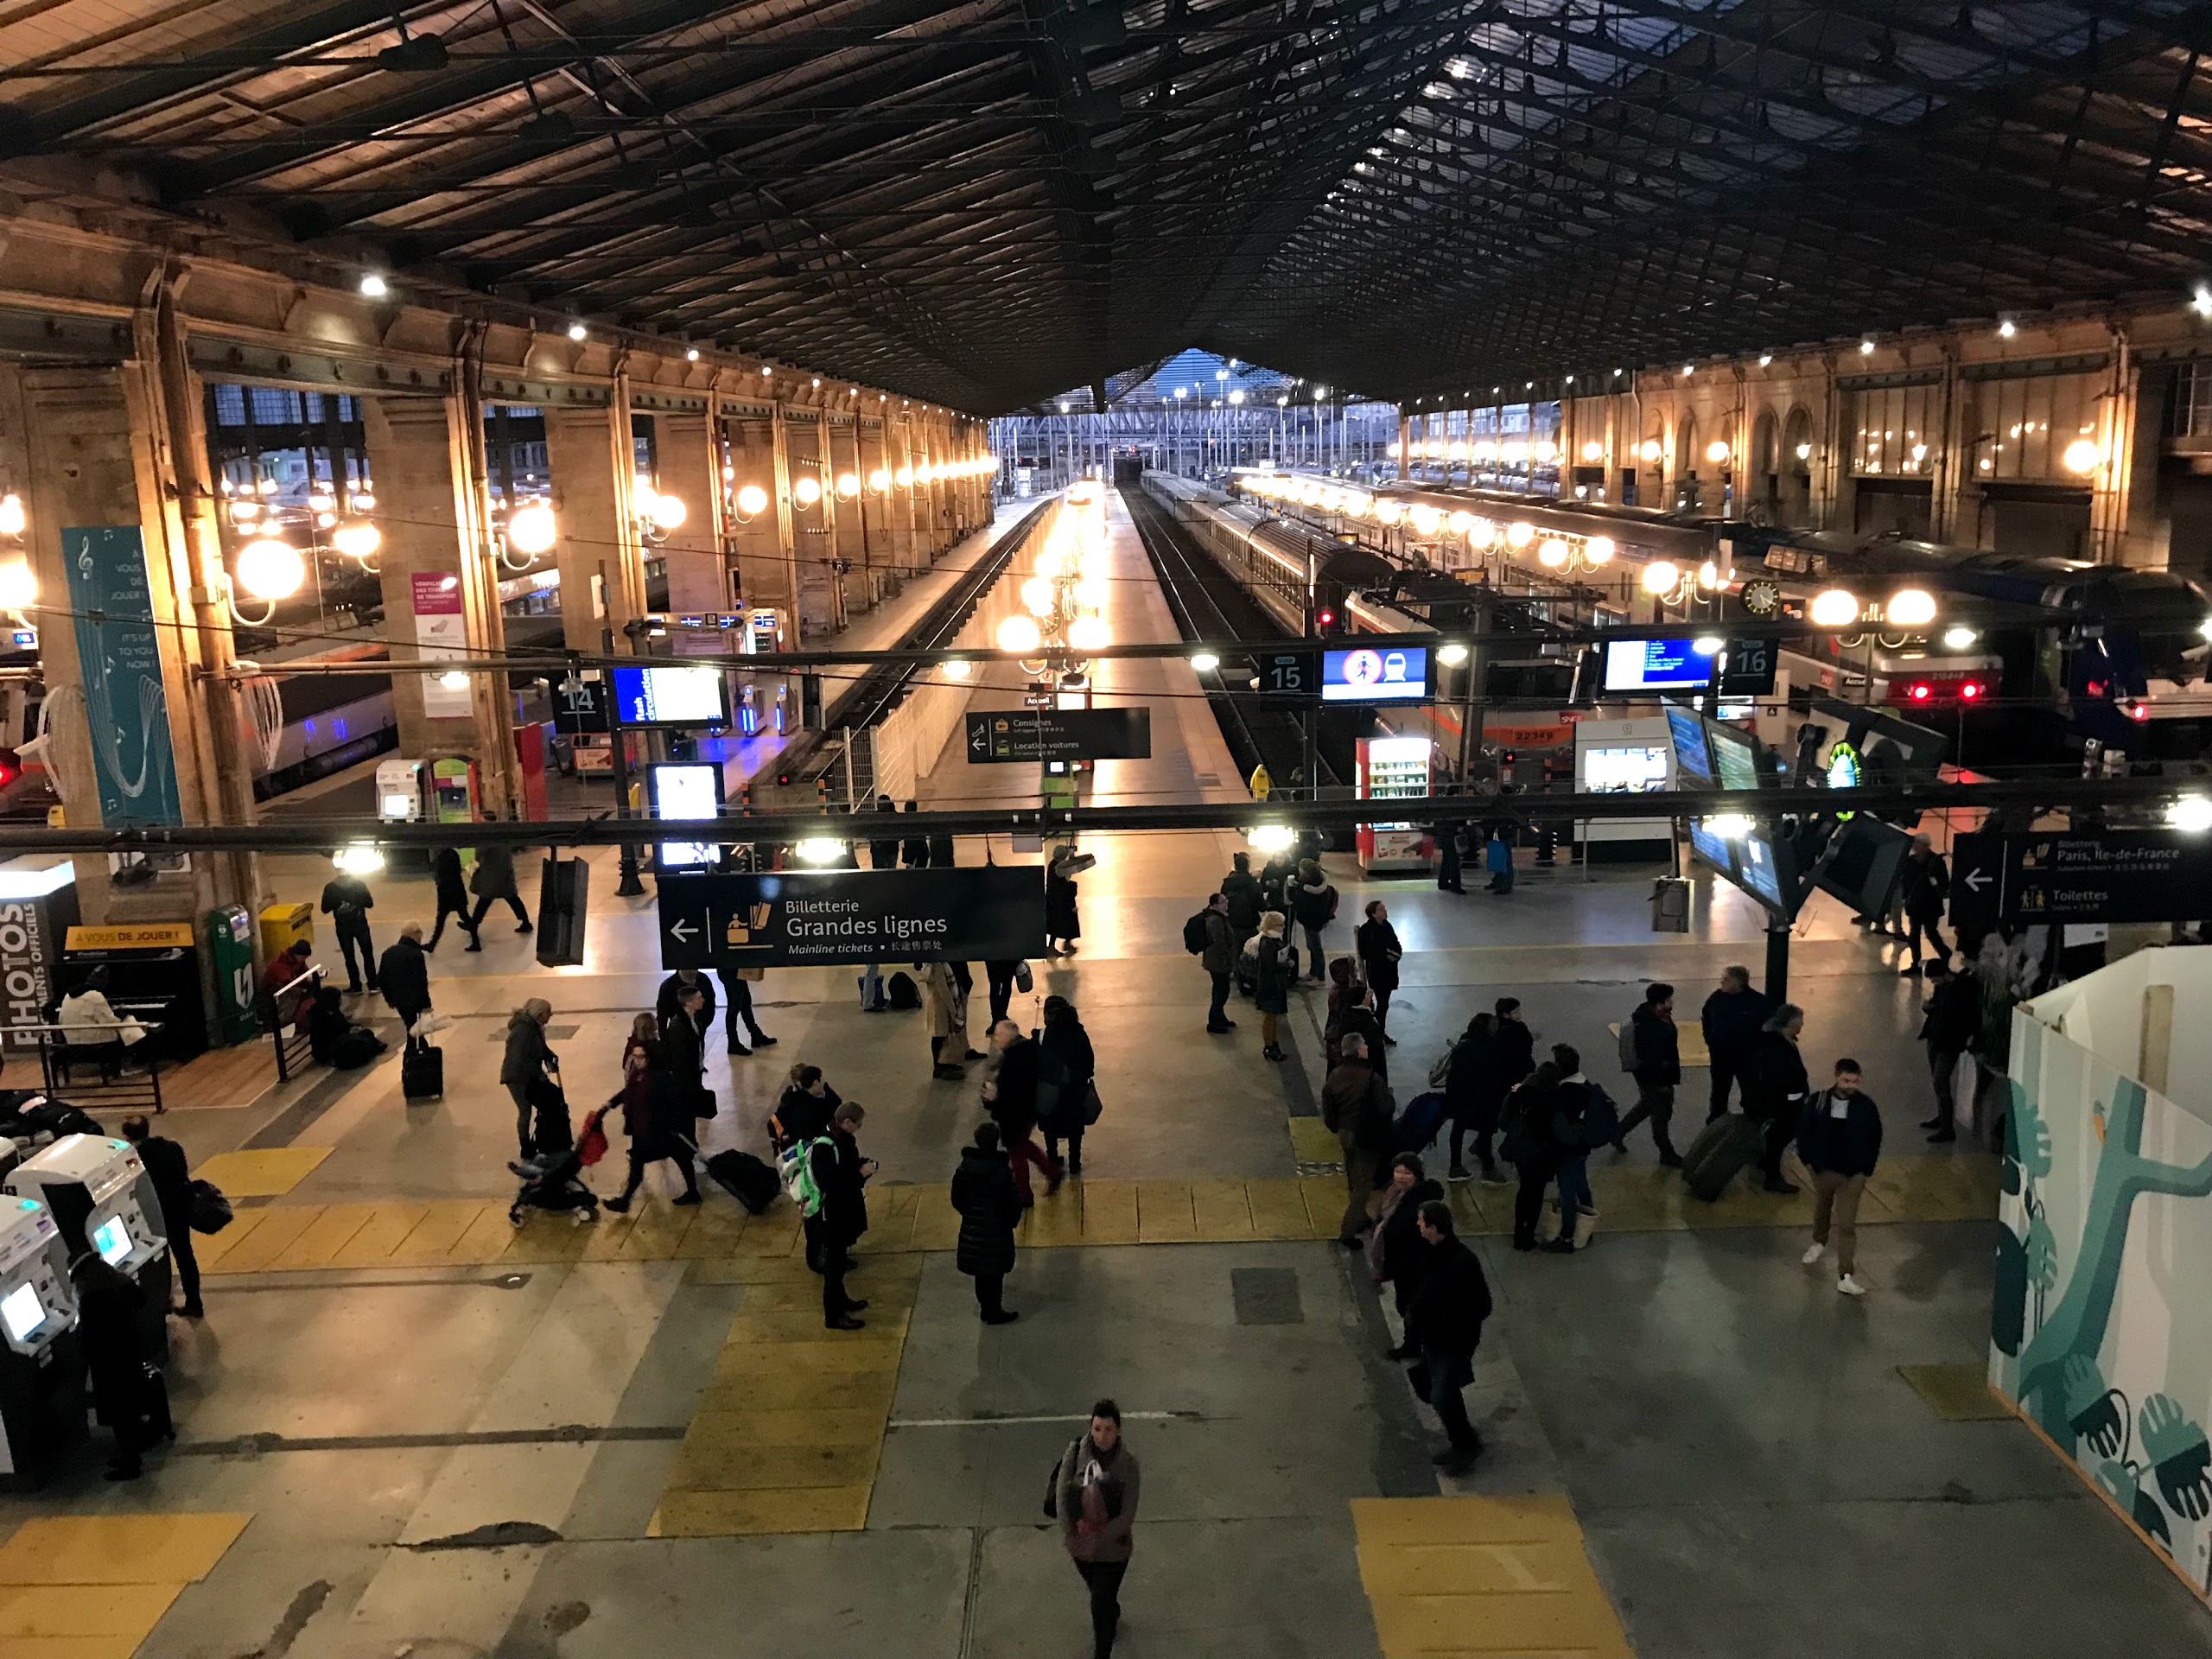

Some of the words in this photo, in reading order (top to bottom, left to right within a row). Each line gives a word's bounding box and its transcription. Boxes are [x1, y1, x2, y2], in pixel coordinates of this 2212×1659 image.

[1737, 650, 1766, 673] 16
[1271, 667, 1300, 689] 15
[562, 689, 594, 710] 14
[634, 696, 645, 721] flash
[1013, 719, 1052, 728] Consignes
[1516, 732, 1553, 741] 22349
[1049, 741, 1080, 749] voitures
[2057, 850, 2091, 862] Paris,
[2053, 889, 2108, 901] Toilettes
[785, 899, 860, 914] Billetterie
[23, 903, 42, 963] OFFICIELS
[786, 915, 878, 938] Grandes
[884, 914, 949, 938] lignes
[86, 932, 116, 942] VOUS
[118, 932, 132, 941] DE
[136, 931, 173, 941] JOUER
[788, 944, 835, 955] Mainline
[837, 942, 874, 954] tickets
[0, 904, 39, 1046] PHOTOS
